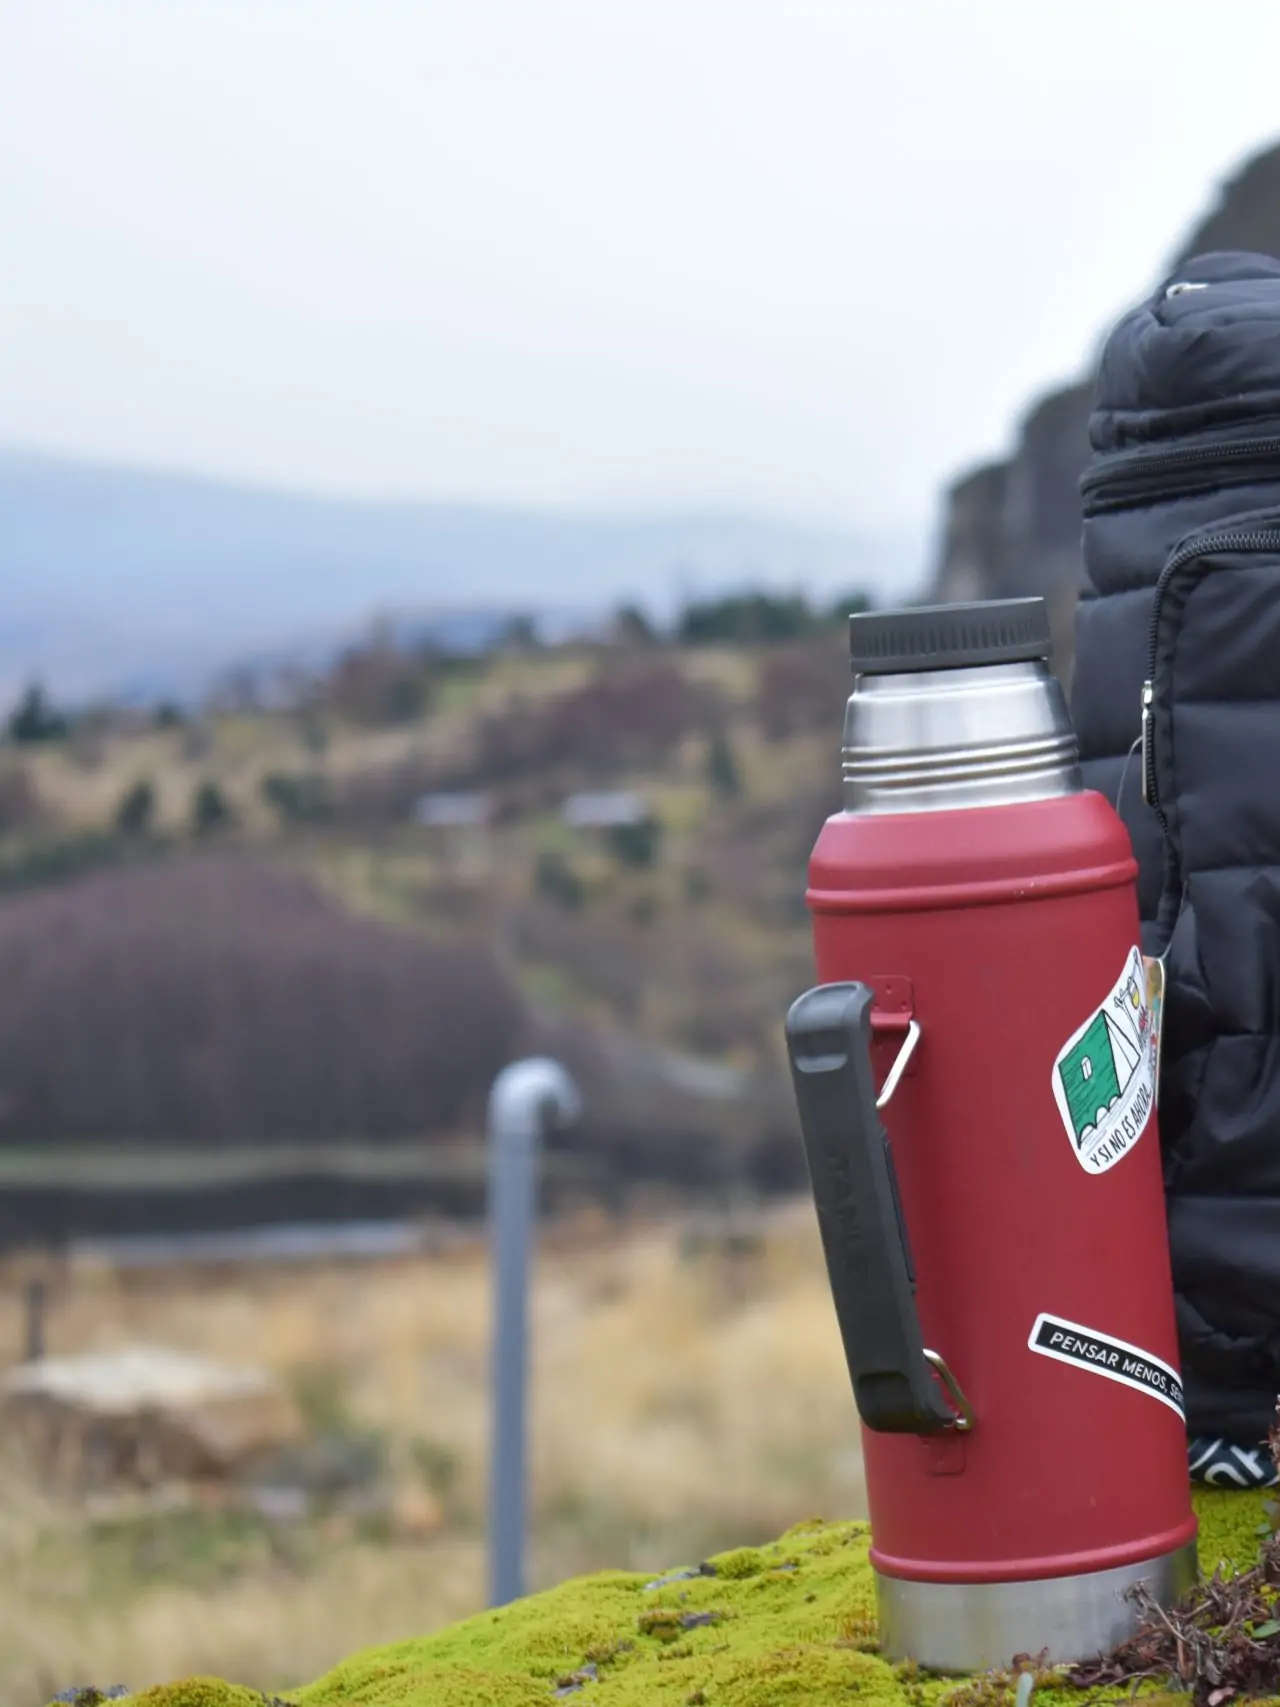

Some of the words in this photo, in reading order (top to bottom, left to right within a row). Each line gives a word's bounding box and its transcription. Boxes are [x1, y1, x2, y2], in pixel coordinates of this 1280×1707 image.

[1090, 1153, 1101, 1168] Y
[1098, 1144, 1114, 1163] SI
[1108, 1128, 1127, 1154] NO
[1121, 1115, 1136, 1140] ES
[1050, 1331, 1120, 1368] PENSAR
[1121, 1358, 1168, 1394] MENOS,
